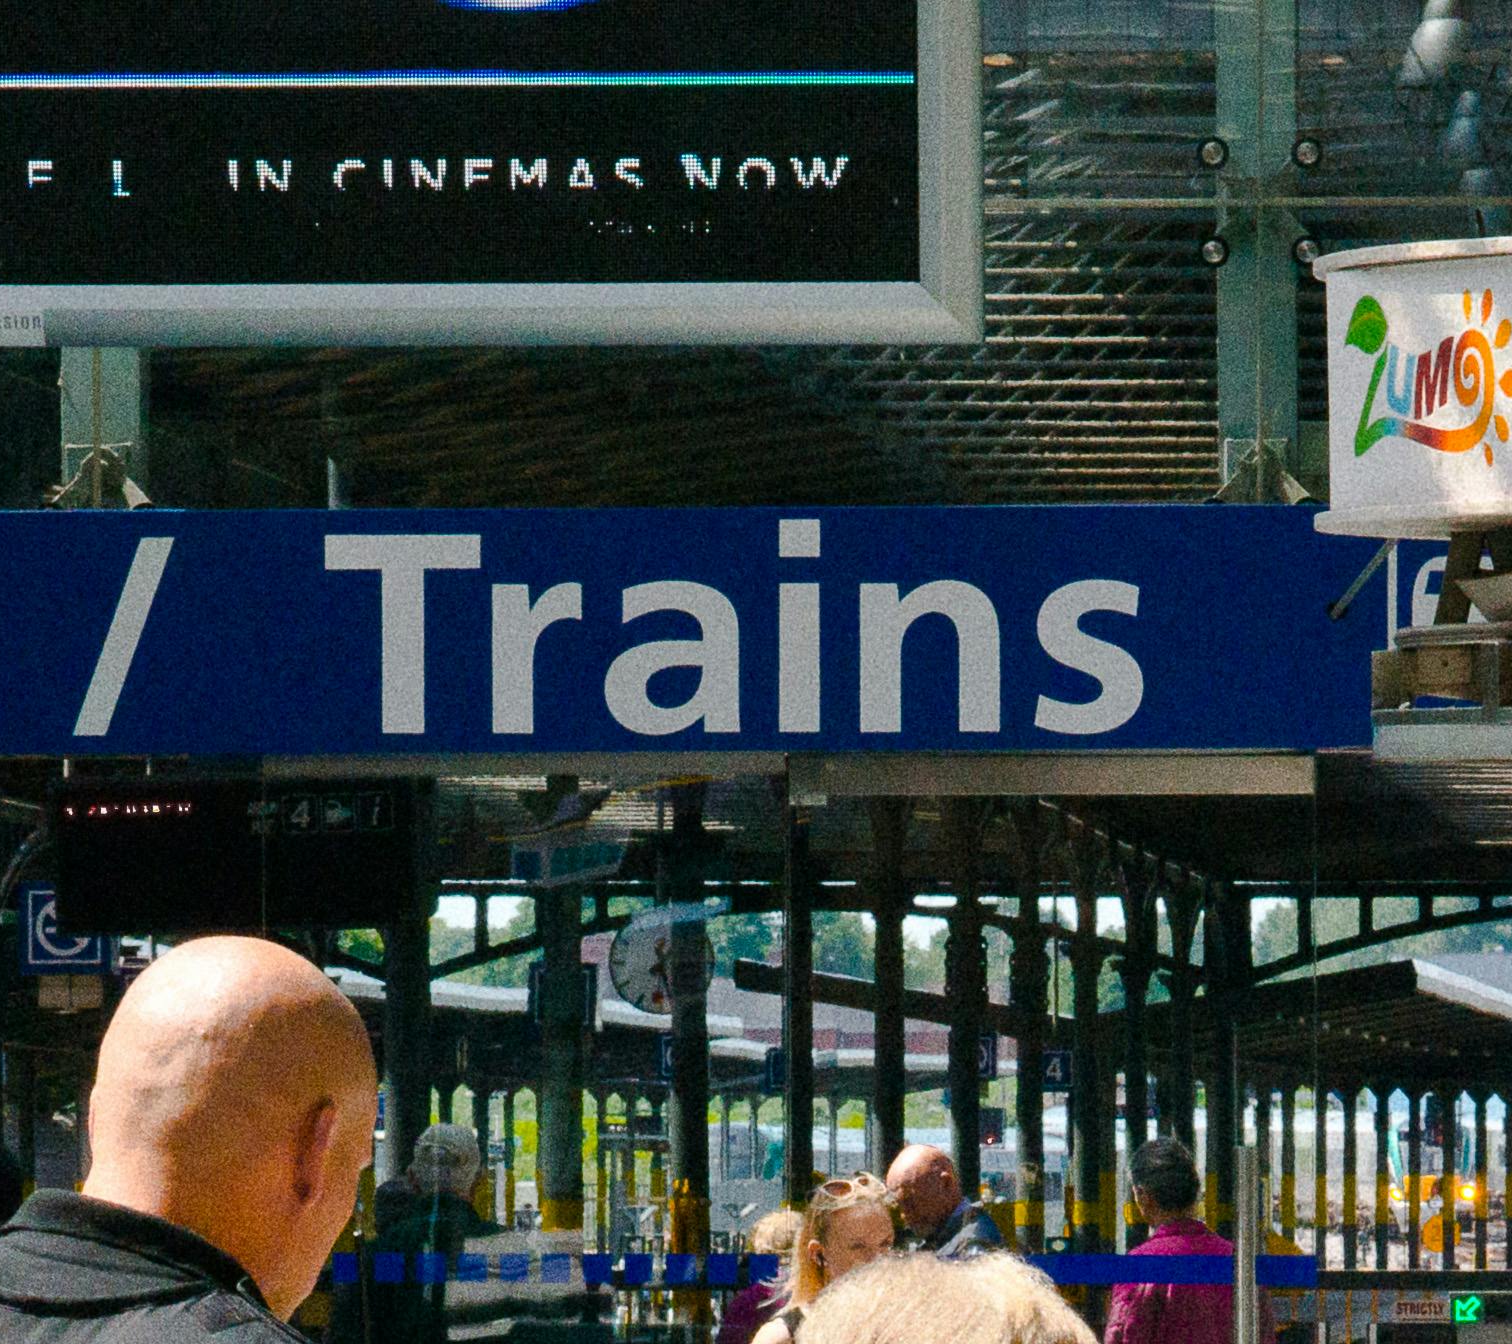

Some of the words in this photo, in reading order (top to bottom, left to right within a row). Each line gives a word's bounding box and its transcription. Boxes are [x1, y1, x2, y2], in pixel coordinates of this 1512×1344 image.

[227, 159, 292, 192] IN
[333, 158, 645, 192] CINEMAS
[680, 154, 849, 190] NOW
[72, 537, 175, 737] /
[324, 518, 1145, 735] Trains
[1395, 1302, 1445, 1317] STRICTLY
